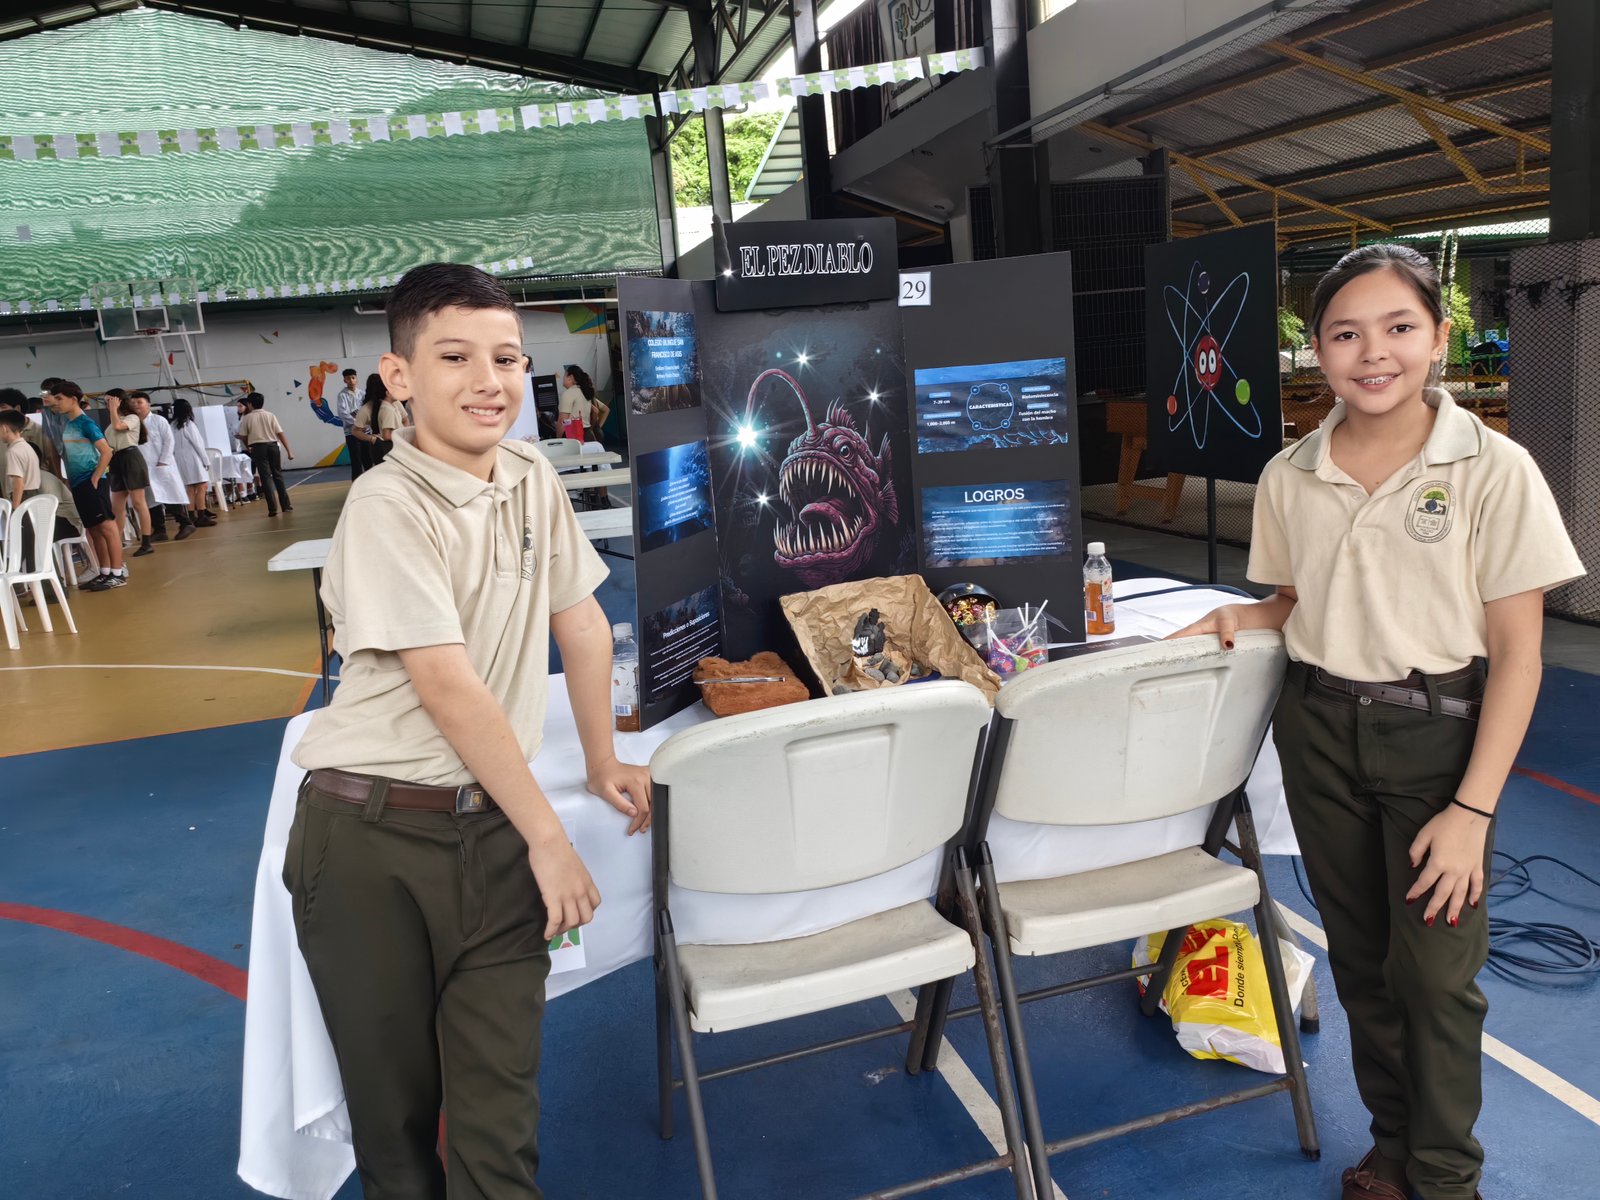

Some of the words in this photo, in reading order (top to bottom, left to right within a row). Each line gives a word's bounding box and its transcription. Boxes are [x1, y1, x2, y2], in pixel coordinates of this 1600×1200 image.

[739, 246, 766, 278] EL
[766, 244, 803, 276] PEZ
[803, 242, 874, 275] DIABLO
[902, 280, 927, 300] 29
[964, 488, 1025, 503] LOGROS
[1234, 972, 1244, 1008] Donde
